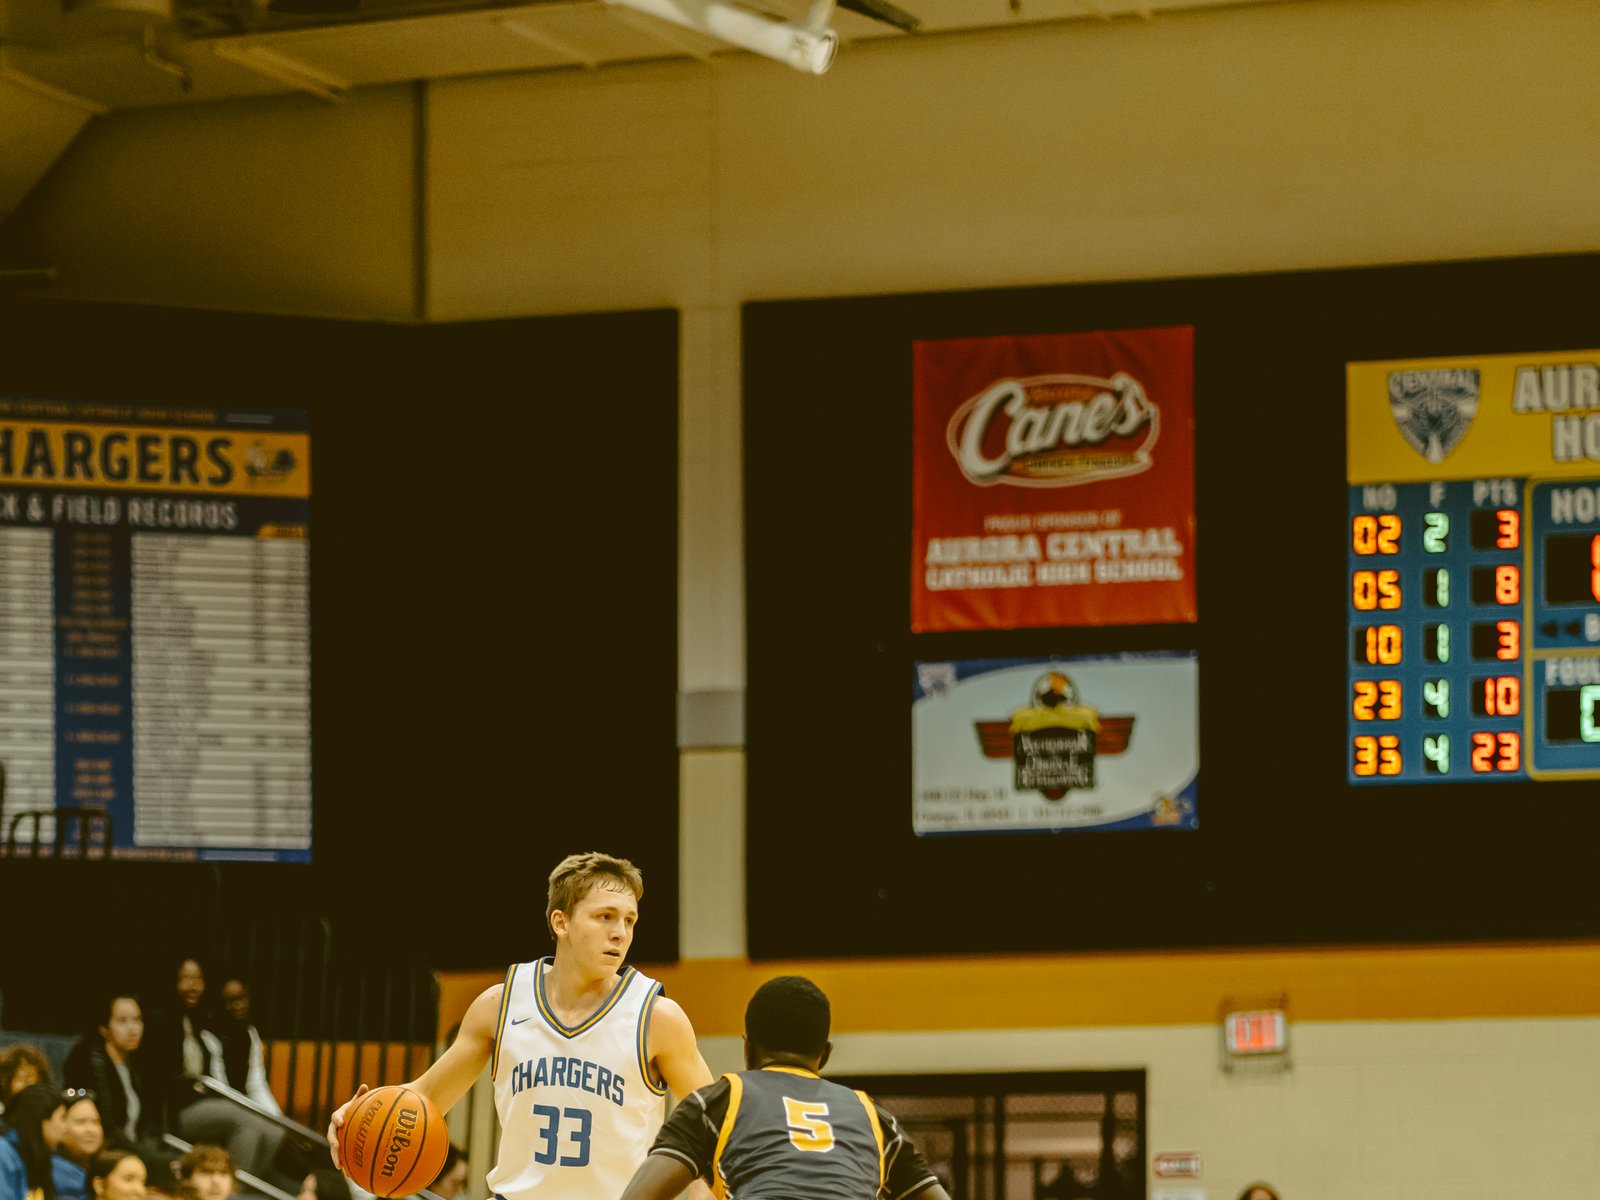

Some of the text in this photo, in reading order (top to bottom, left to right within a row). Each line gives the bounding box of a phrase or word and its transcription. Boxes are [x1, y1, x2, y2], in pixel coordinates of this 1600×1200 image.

[27, 493, 44, 521] &
[52, 494, 120, 525] FIELD
[129, 497, 238, 530] RECORDS
[1473, 478, 1518, 507] PTS
[926, 527, 1183, 565] AURORA CENTRAL
[1353, 509, 1520, 554] 02 2 3
[1353, 564, 1520, 610] 05 1 8
[1366, 620, 1520, 665] 10 1 3
[1353, 675, 1520, 720] 23 4 10
[1354, 731, 1520, 776] 35 4 23
[512, 1057, 625, 1106] CHARGERS
[353, 1100, 383, 1168] EVOLUTION
[380, 1108, 419, 1178] Wilson
[533, 1104, 592, 1167] 33
[782, 1096, 835, 1153] 5
